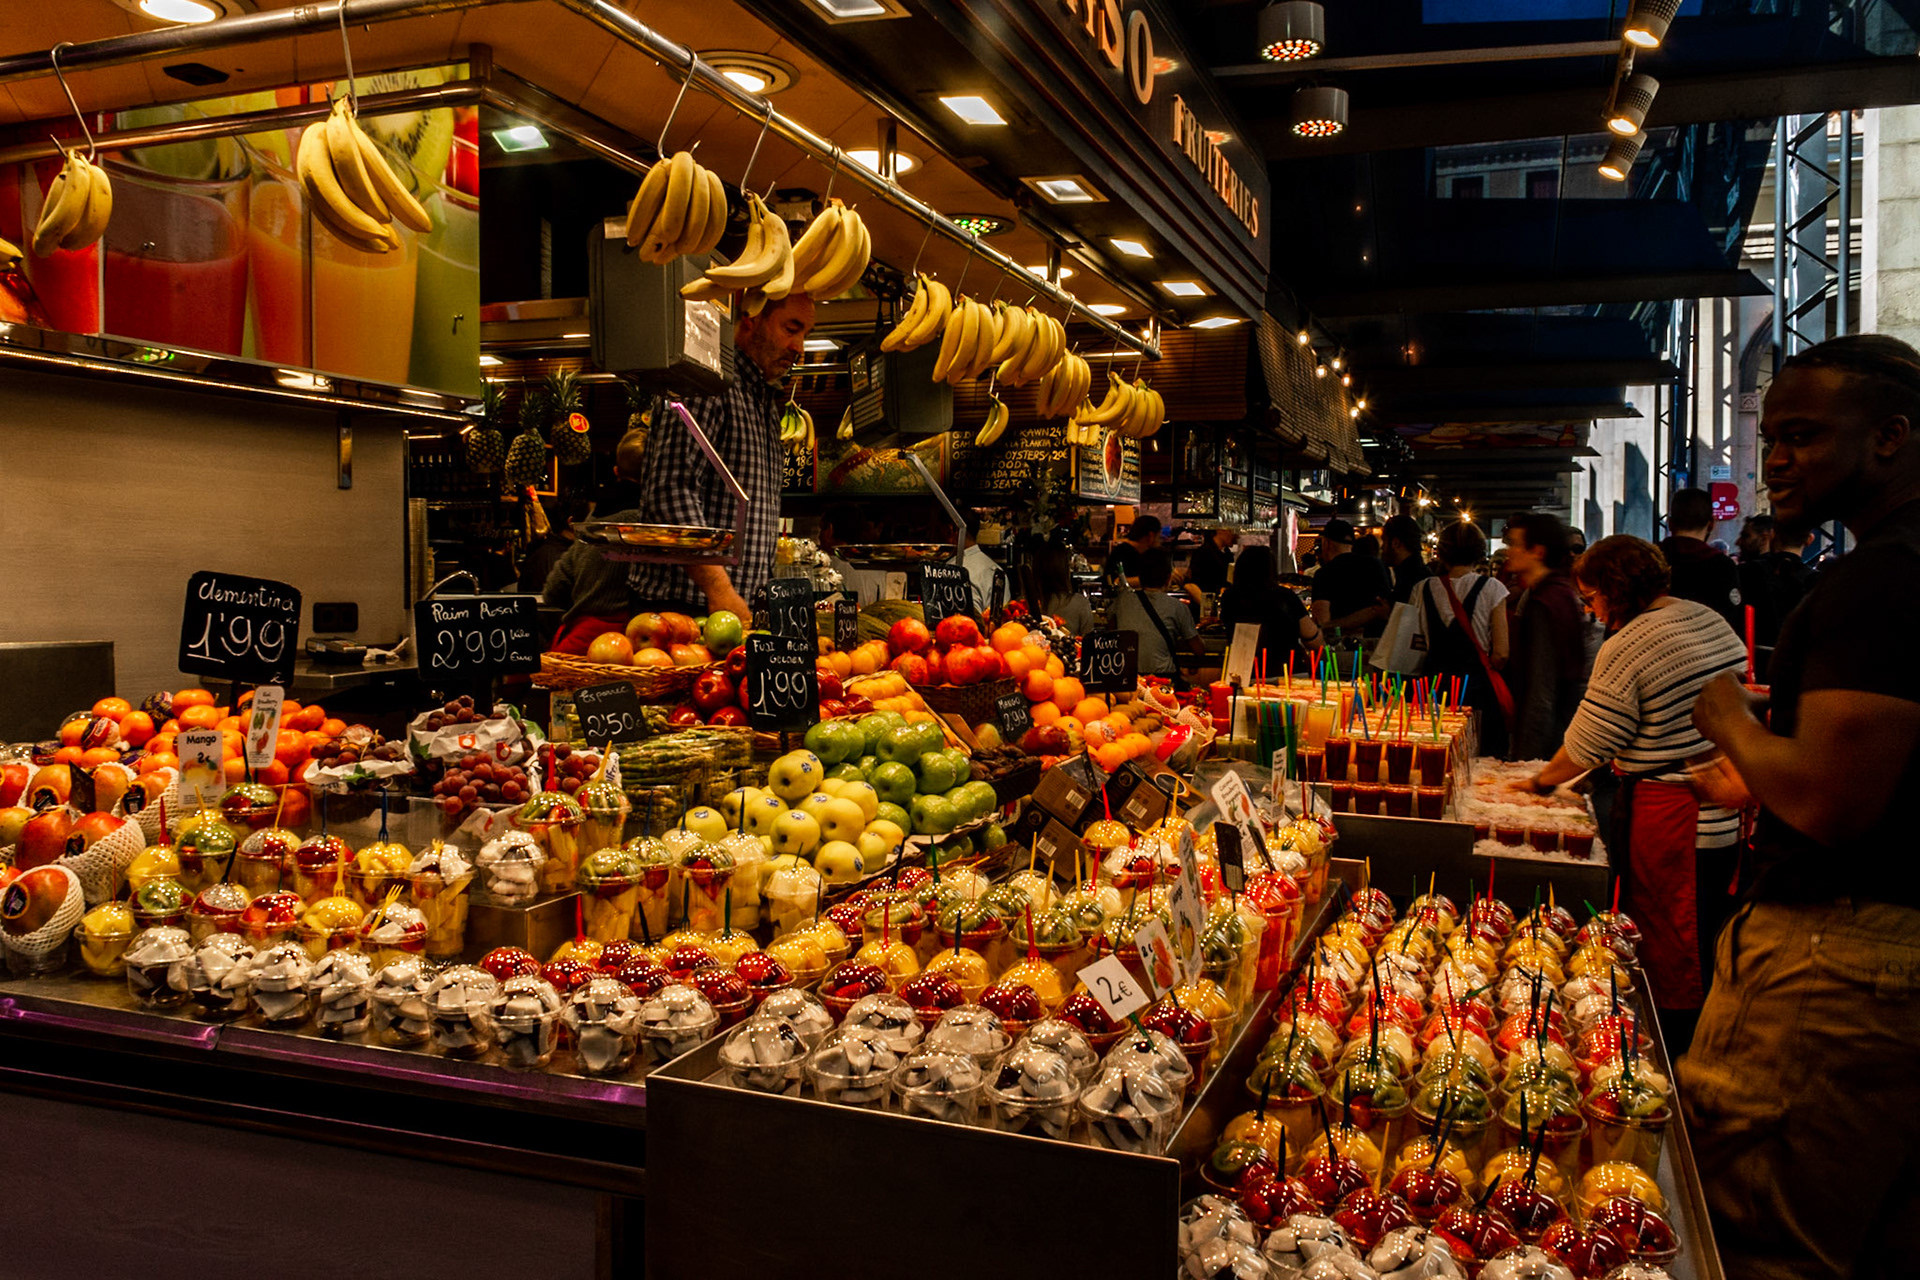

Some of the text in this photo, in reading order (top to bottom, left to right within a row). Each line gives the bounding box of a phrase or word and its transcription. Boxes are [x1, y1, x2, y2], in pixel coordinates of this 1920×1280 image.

[1172, 93, 1259, 239] FRUITERIES
[431, 602, 470, 623] Raim
[186, 612, 286, 664] 1'99
[432, 628, 508, 669] 2'99
[1082, 651, 1126, 685] 1'99
[752, 668, 809, 717] 1'99
[186, 735, 217, 746] Mango
[1096, 976, 1133, 1005] 2€
